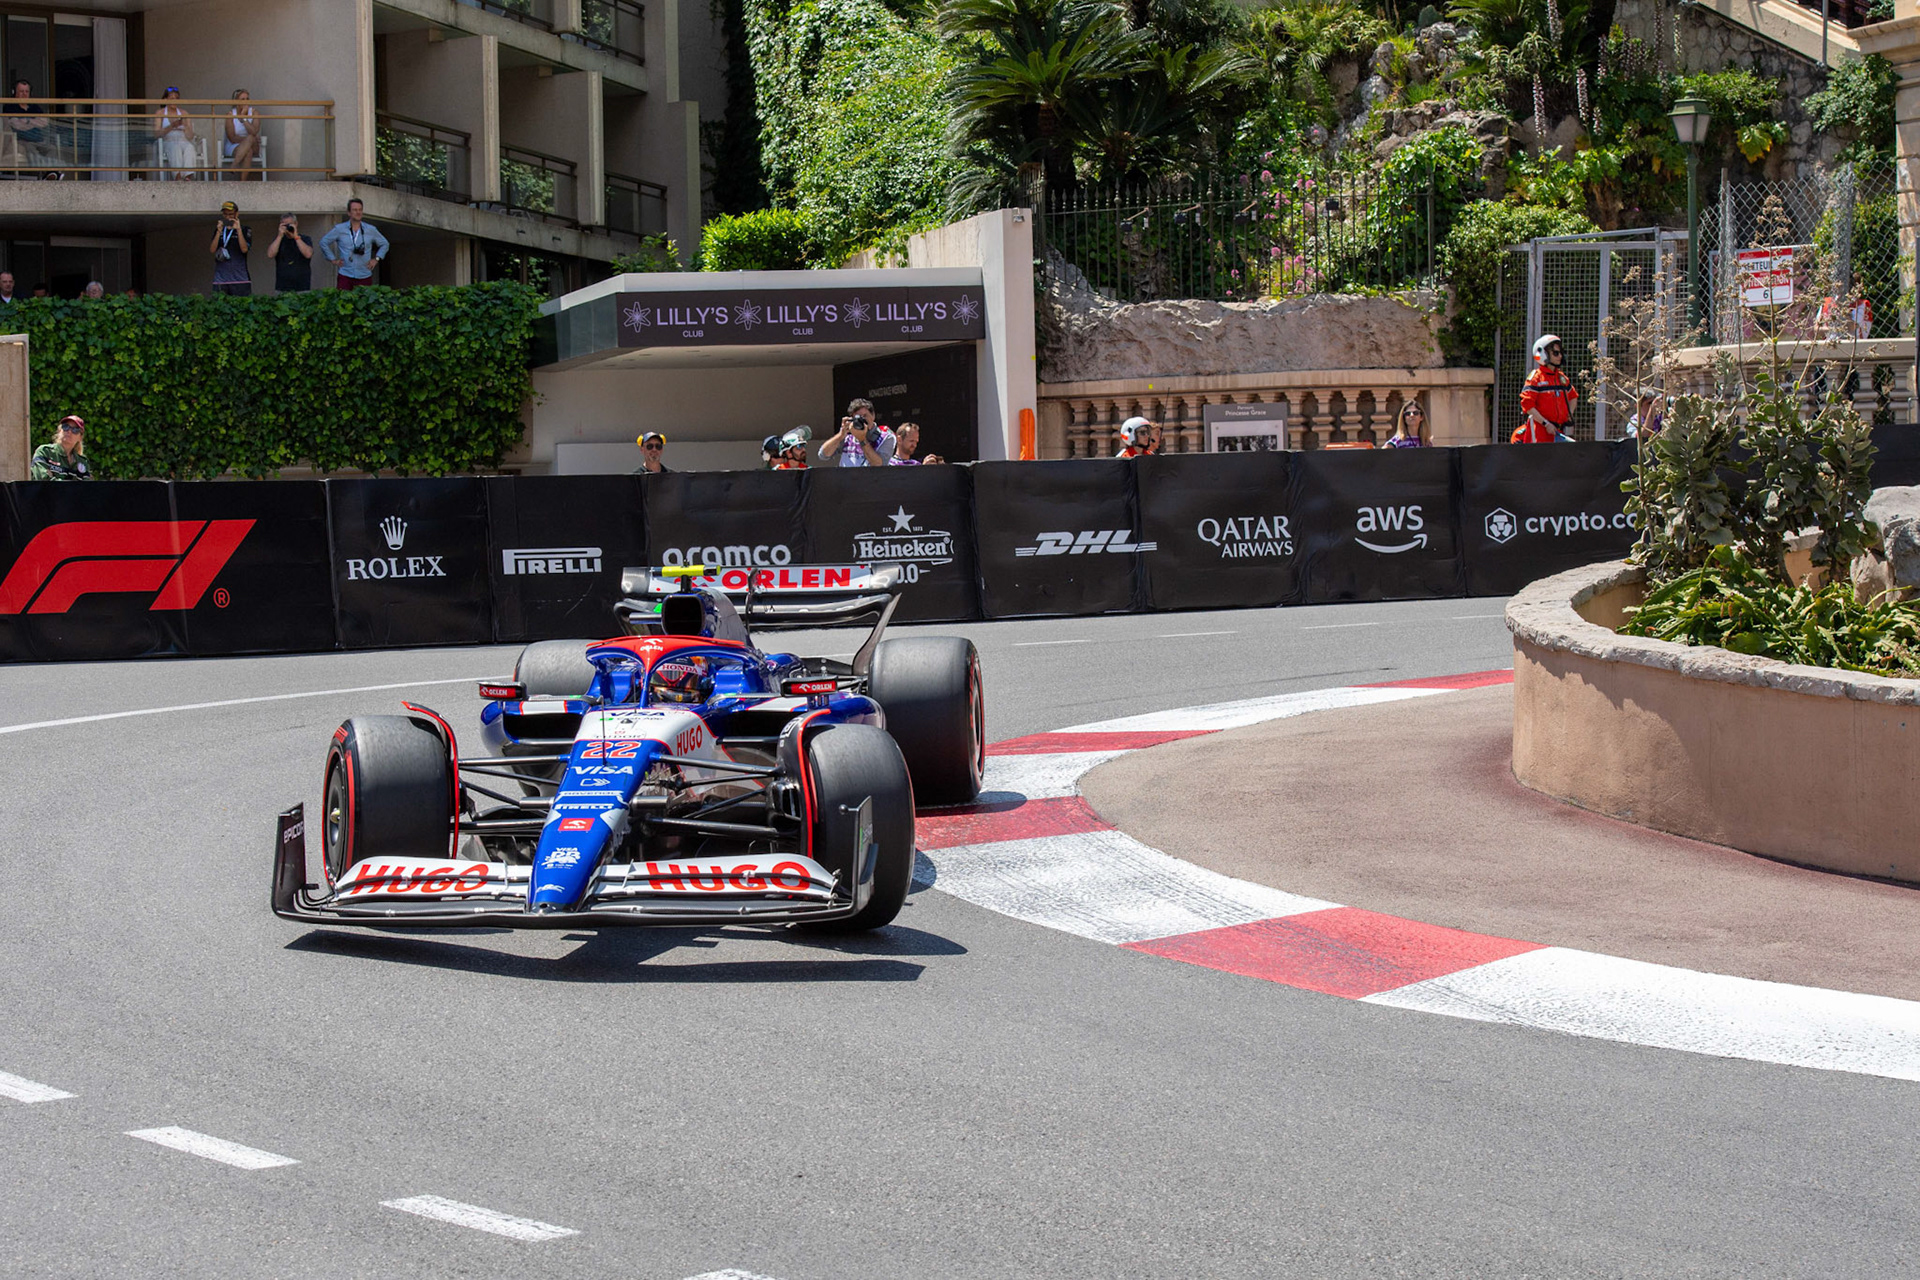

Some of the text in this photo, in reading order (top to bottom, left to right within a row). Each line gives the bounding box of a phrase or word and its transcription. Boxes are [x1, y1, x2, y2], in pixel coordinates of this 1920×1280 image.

[1763, 289, 1769, 299] 6
[656, 307, 728, 326] LILLY'S
[766, 305, 838, 324] LILLY'S
[875, 302, 947, 321] LILLY'S
[682, 329, 704, 338] CLUB
[792, 327, 814, 336] CLUB
[901, 325, 923, 333] CLUB
[1357, 505, 1424, 532] aws
[1525, 512, 1638, 536] crypto.co
[1197, 515, 1292, 547] QATAR
[859, 539, 947, 558] Heineken
[1035, 530, 1139, 556] DHL
[1221, 541, 1294, 558] AIRWAYS
[502, 547, 602, 575] PIRELLI
[662, 545, 791, 567] aramco
[347, 556, 446, 580] ROLEX
[721, 568, 851, 590] ORLEN
[662, 664, 698, 673] HONDA
[811, 683, 832, 691] ORLEN
[580, 741, 641, 759] 22
[676, 725, 703, 757] HUGO
[571, 766, 633, 775] VISA
[350, 864, 488, 895] HUGO
[646, 861, 811, 892] HUGO
